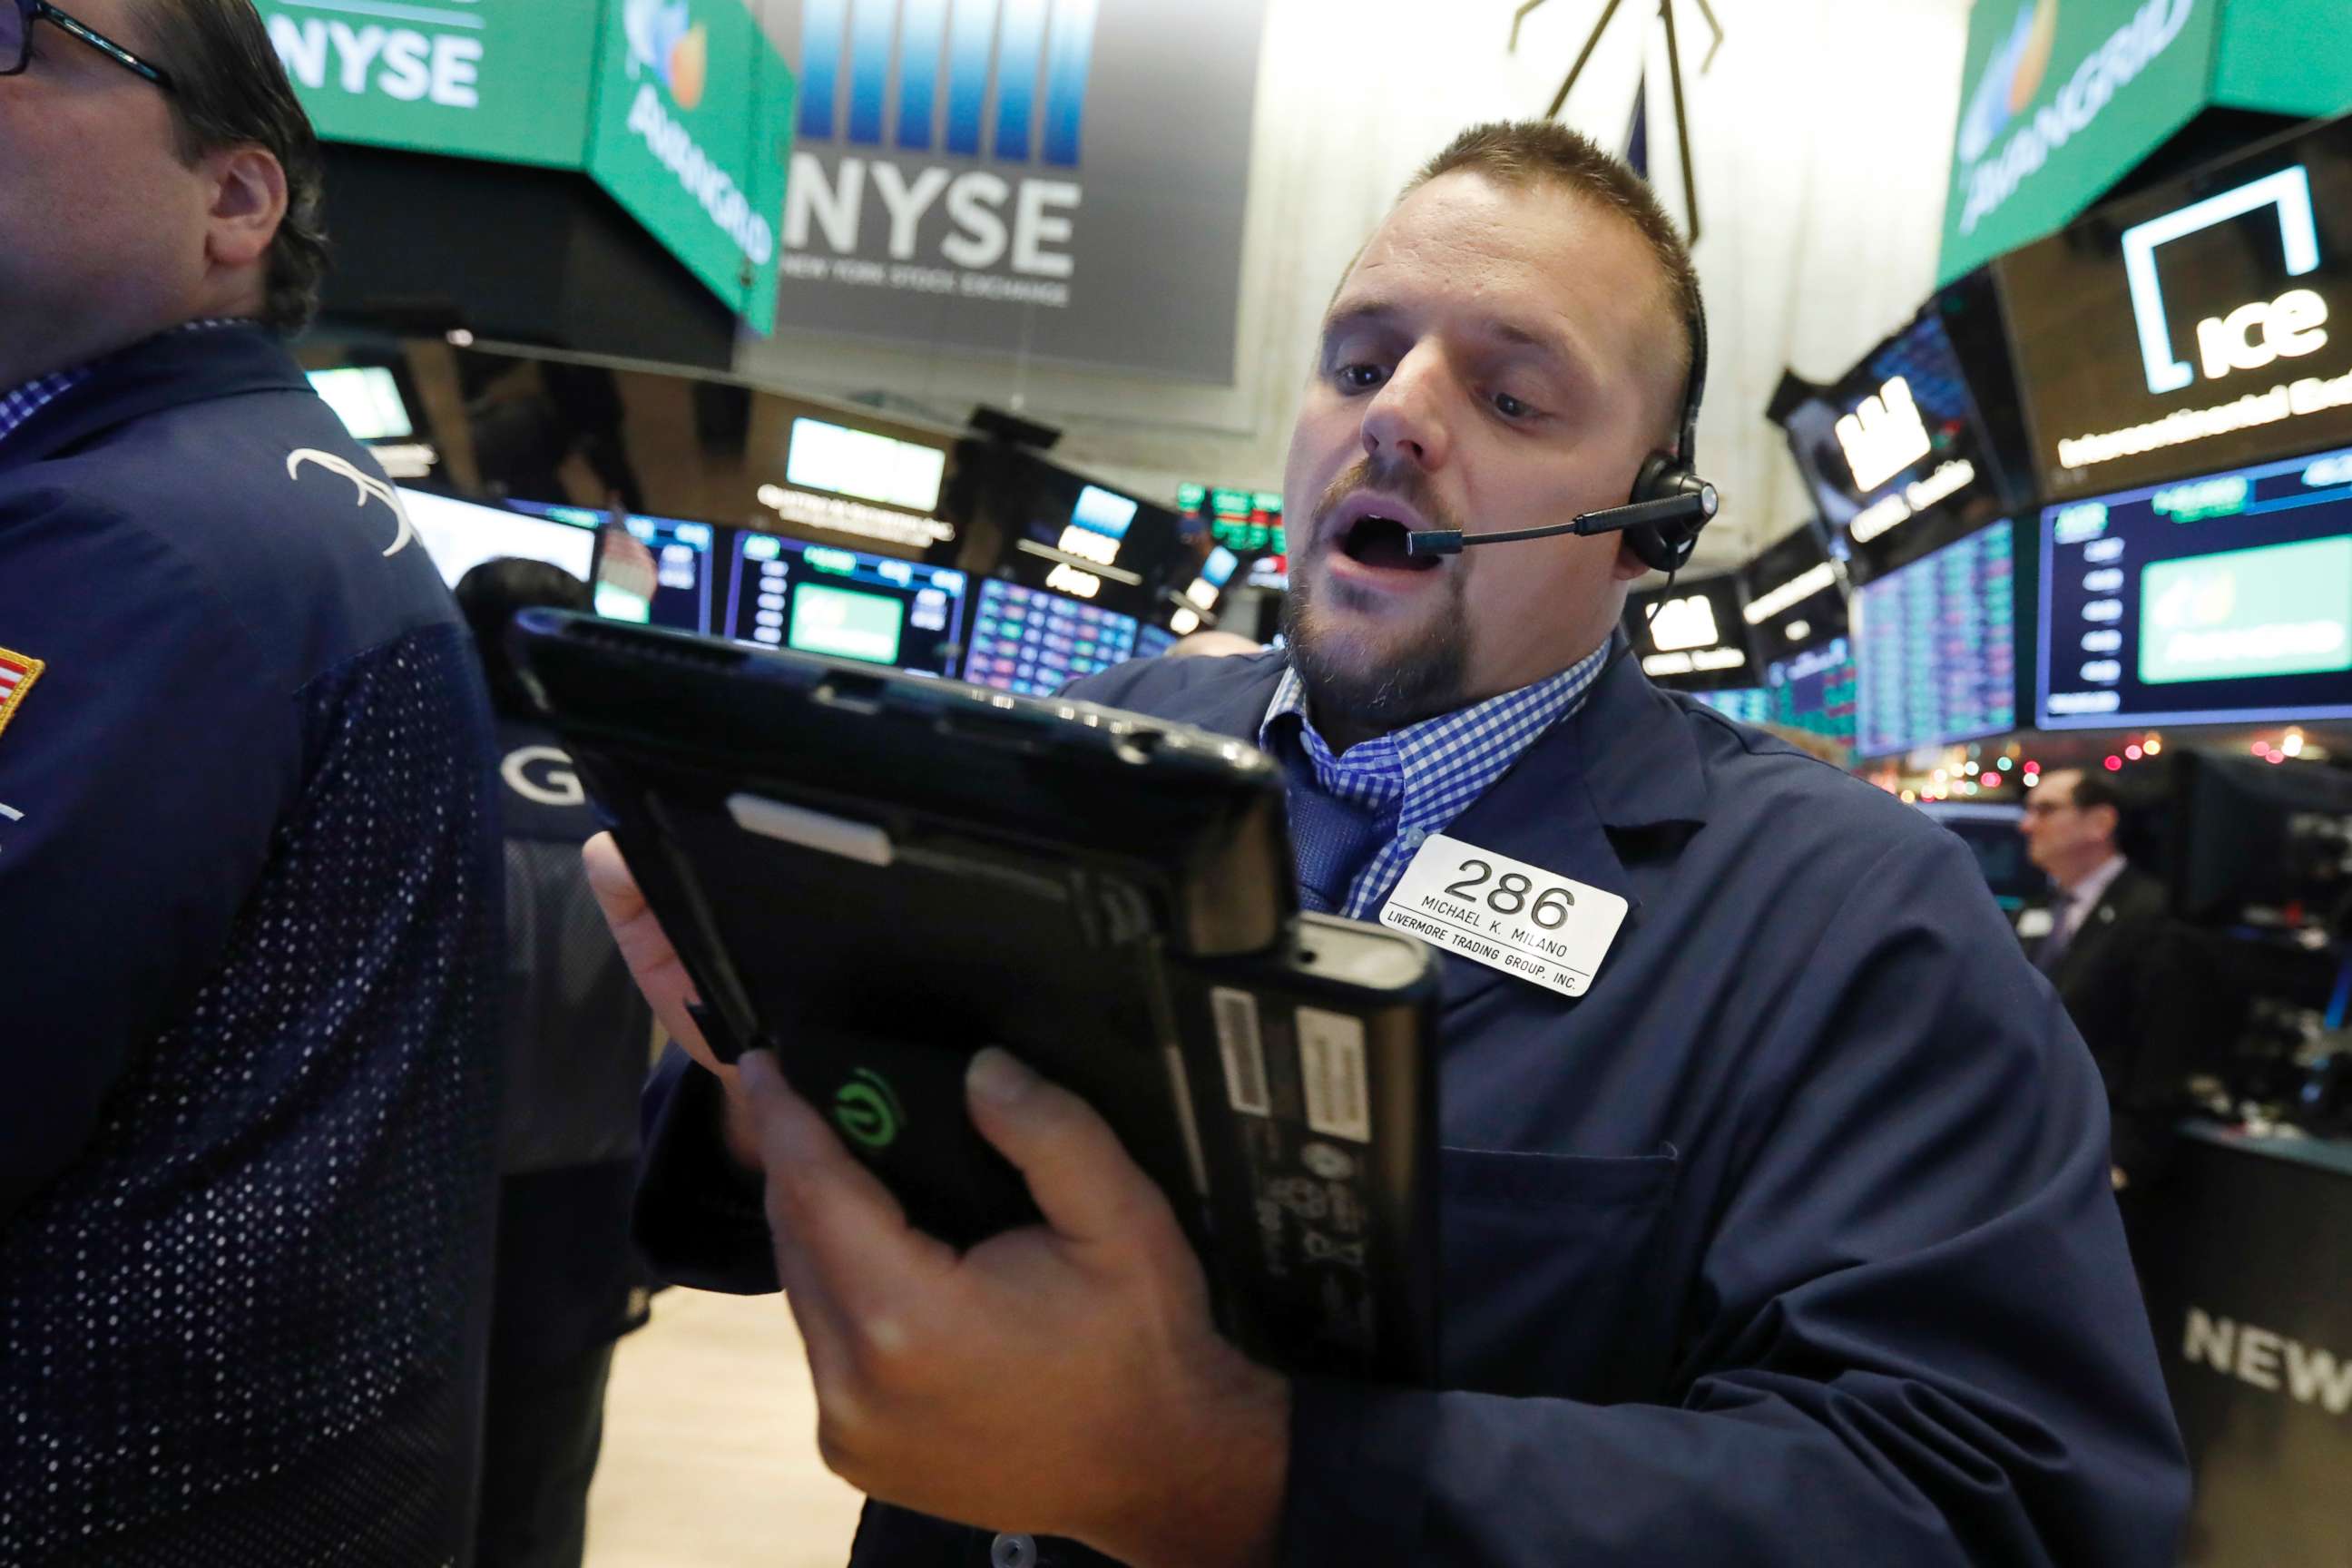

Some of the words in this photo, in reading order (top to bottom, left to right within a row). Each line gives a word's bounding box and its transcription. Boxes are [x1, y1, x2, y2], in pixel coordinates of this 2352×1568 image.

[266, 13, 485, 109] NYSE
[782, 152, 1083, 278] NYSE
[1421, 895, 1481, 927] MICHAEL
[1489, 920, 1502, 936] K.
[1511, 927, 1568, 958] MILANO
[1444, 858, 1575, 930] 286
[1387, 910, 1449, 941] LIVERMORE
[1452, 935, 1500, 960] TRADING
[1553, 972, 1577, 991] INC.
[2181, 1306, 2352, 1415] NEW
